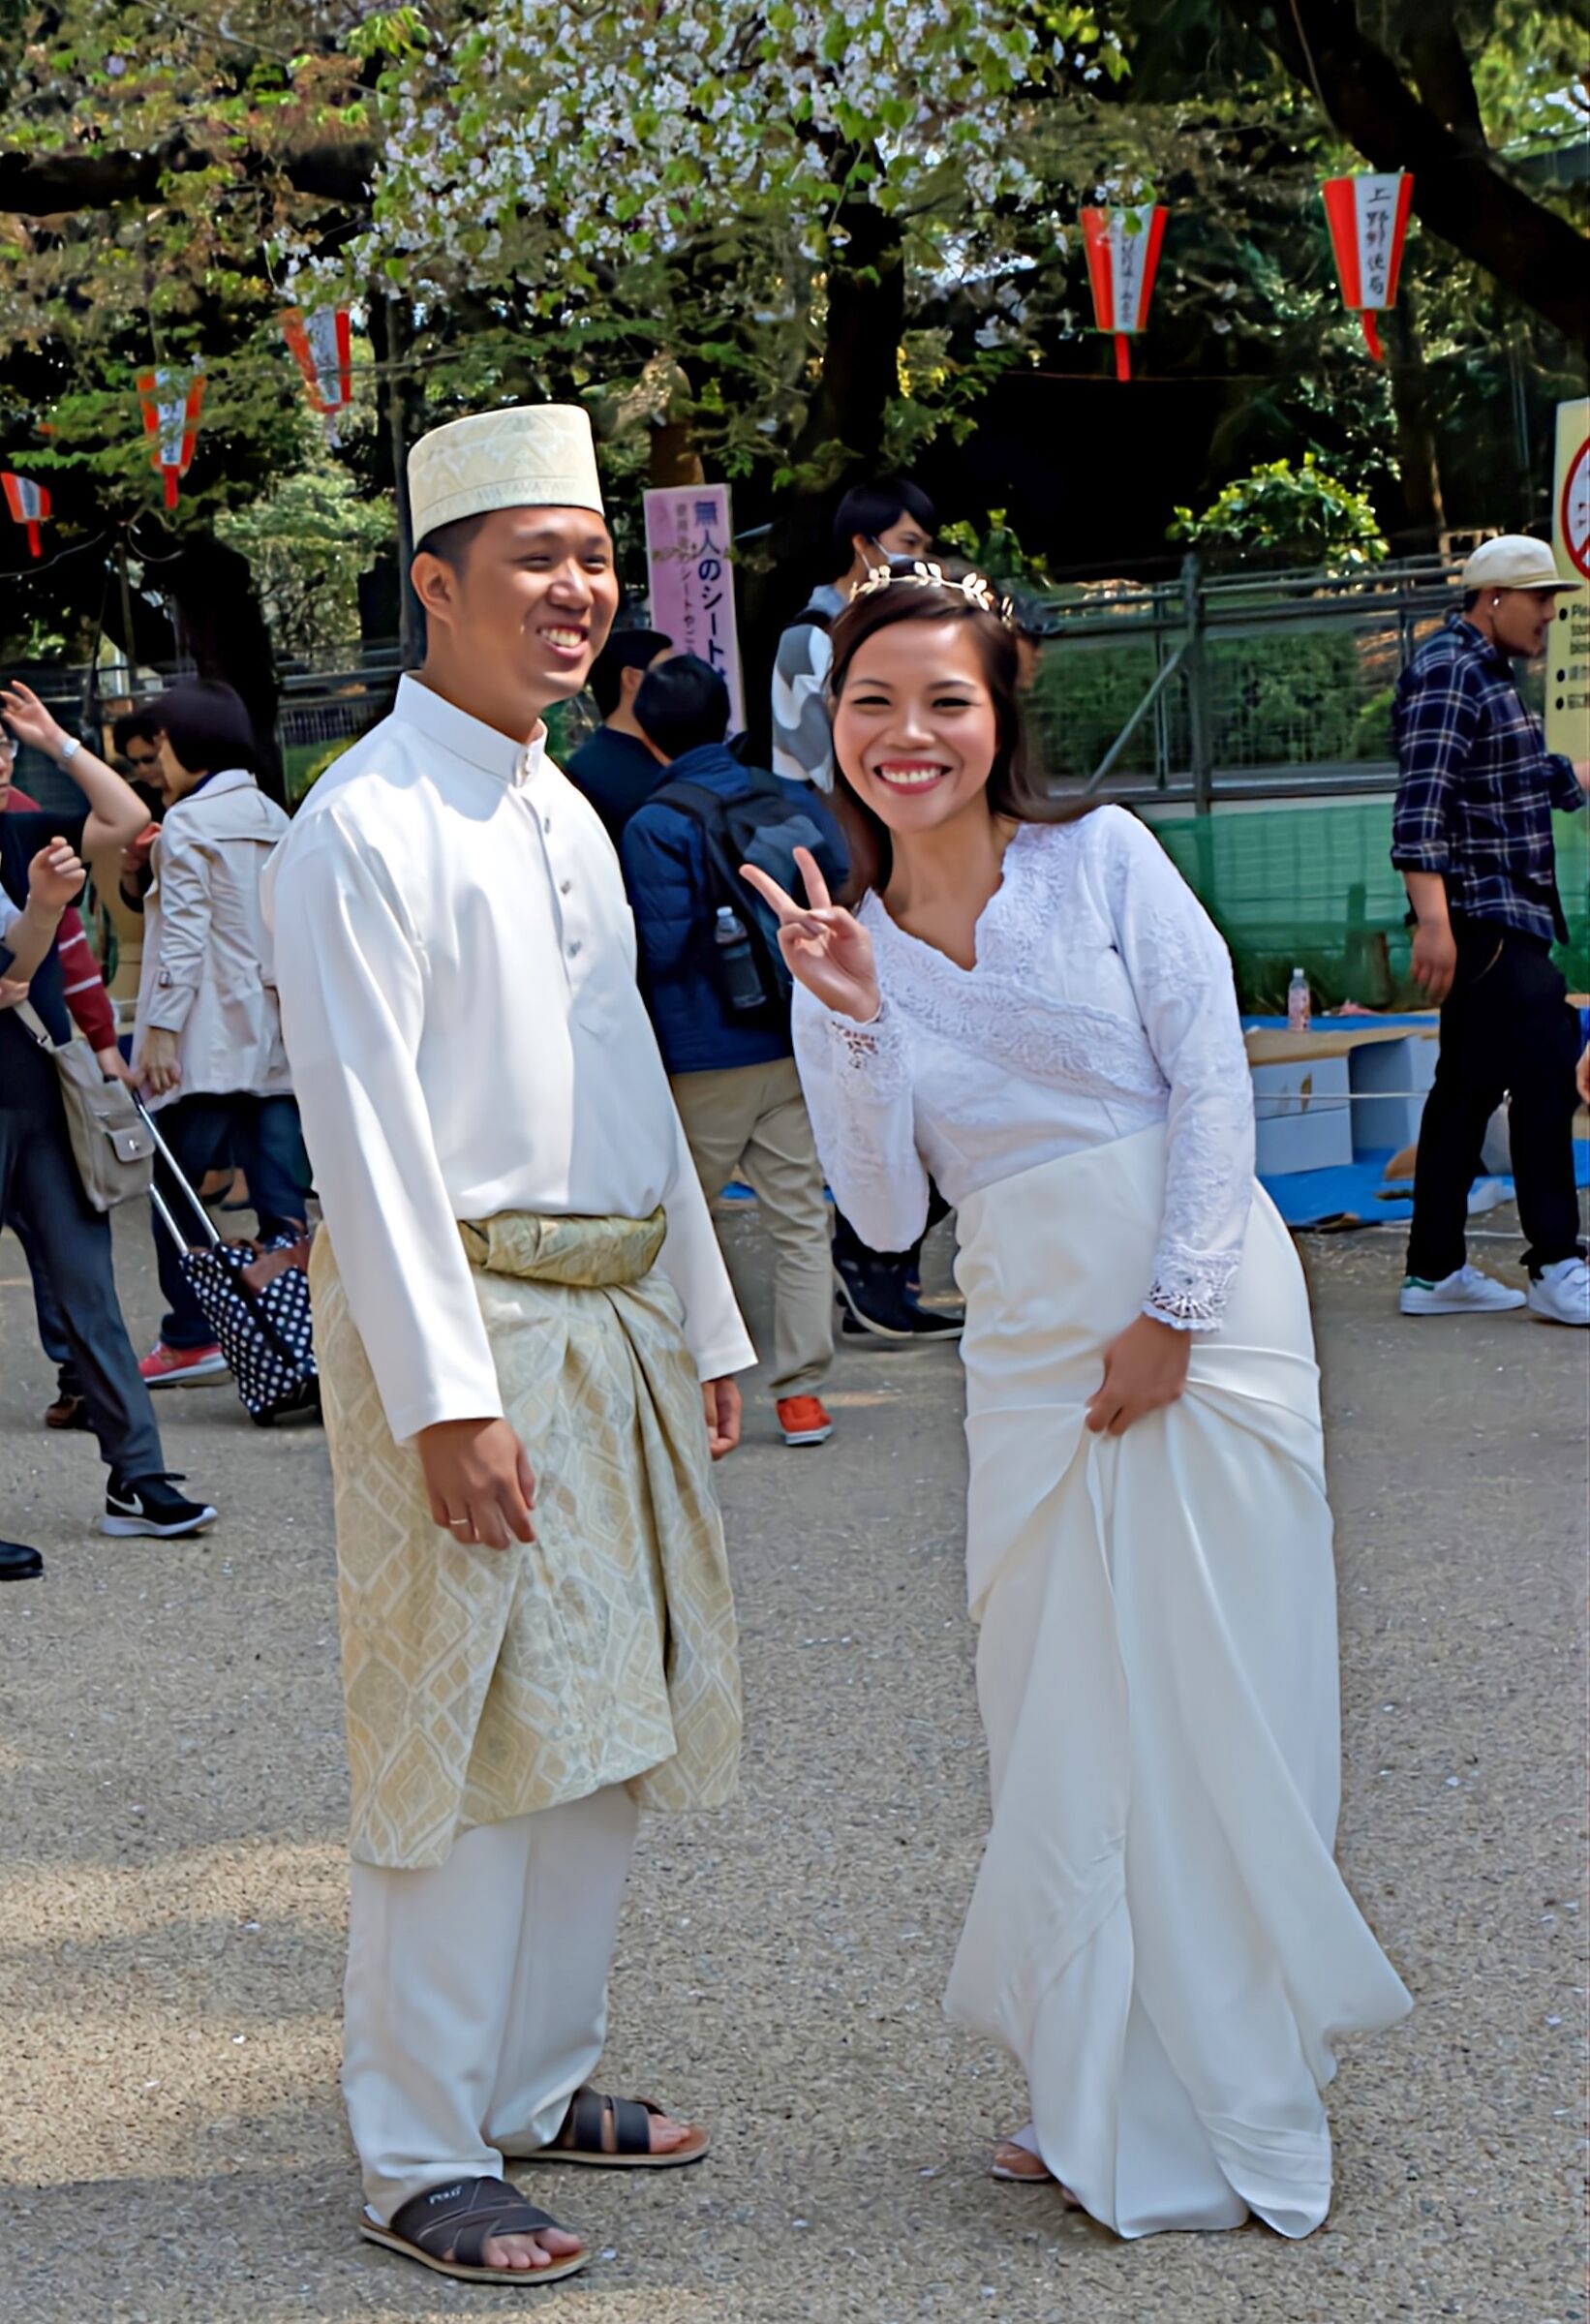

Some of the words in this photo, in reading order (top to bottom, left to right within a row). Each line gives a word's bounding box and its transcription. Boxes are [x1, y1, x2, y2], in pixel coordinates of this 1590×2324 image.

[692, 501, 725, 678] 無人のシート
